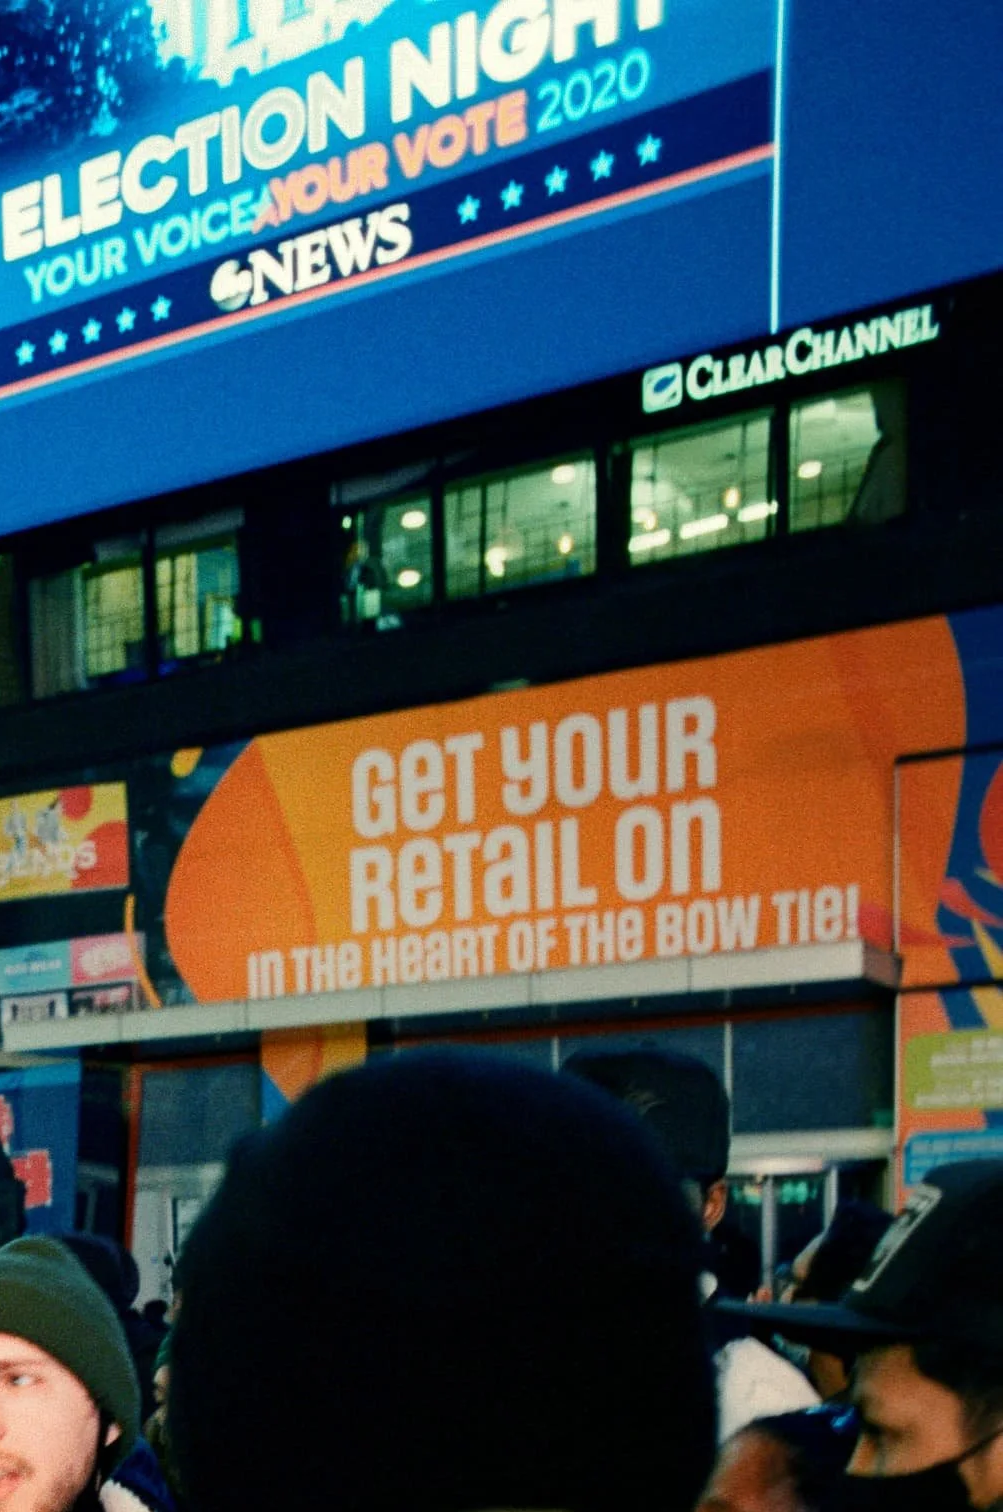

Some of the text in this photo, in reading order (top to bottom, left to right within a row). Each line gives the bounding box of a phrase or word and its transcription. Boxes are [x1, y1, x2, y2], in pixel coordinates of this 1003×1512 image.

[1, 56, 366, 262] ELECTION
[23, 47, 651, 304] YOUR VOICE YOUR VOTE 2020
[247, 202, 414, 307] NEWS
[507, 916, 557, 973] OF
[653, 891, 762, 958] BOW
